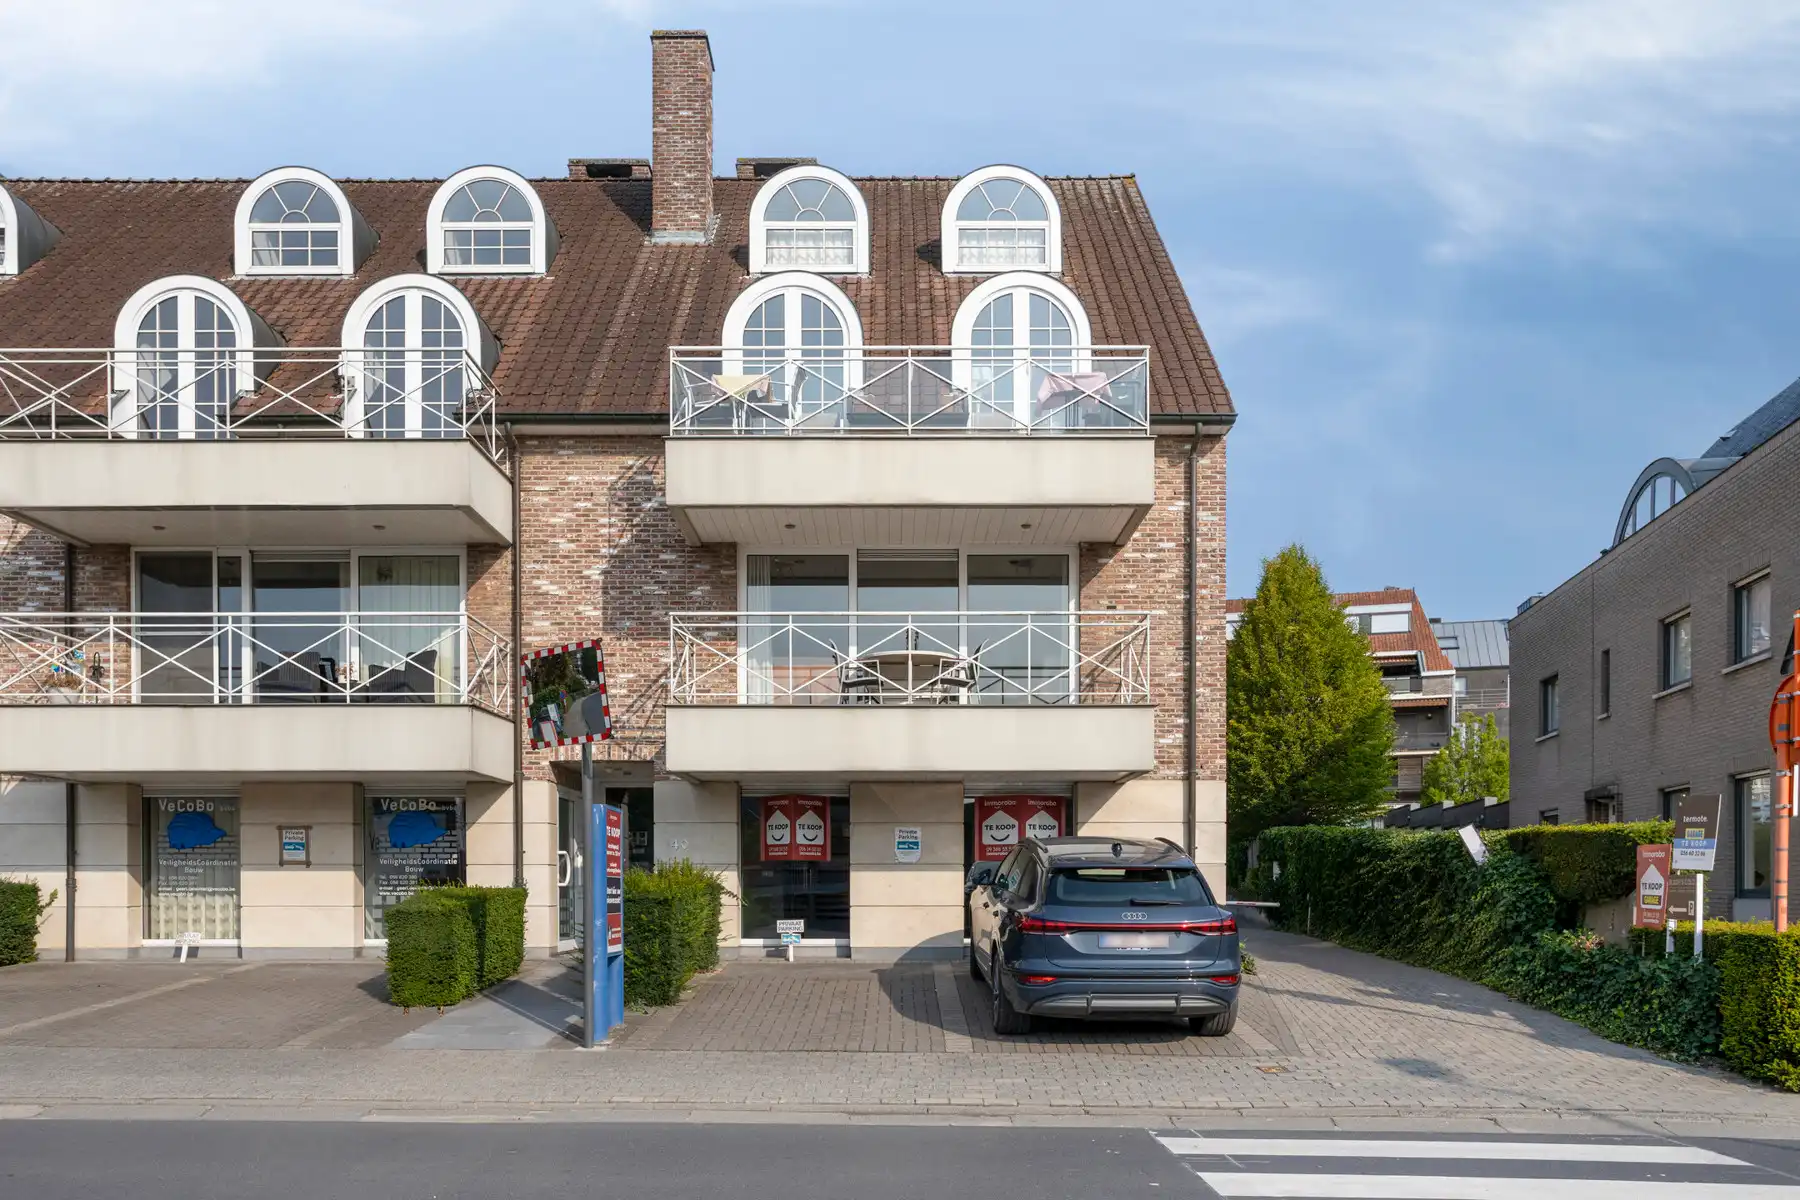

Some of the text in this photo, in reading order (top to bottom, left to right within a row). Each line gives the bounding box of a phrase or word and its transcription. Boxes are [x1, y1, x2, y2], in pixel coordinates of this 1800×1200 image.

[158, 799, 215, 812] VeCoBo
[380, 798, 437, 811] VeCoBo
[807, 823, 823, 831] KOOP
[1642, 882, 1648, 890] TE
[1648, 882, 1663, 891] KOOP
